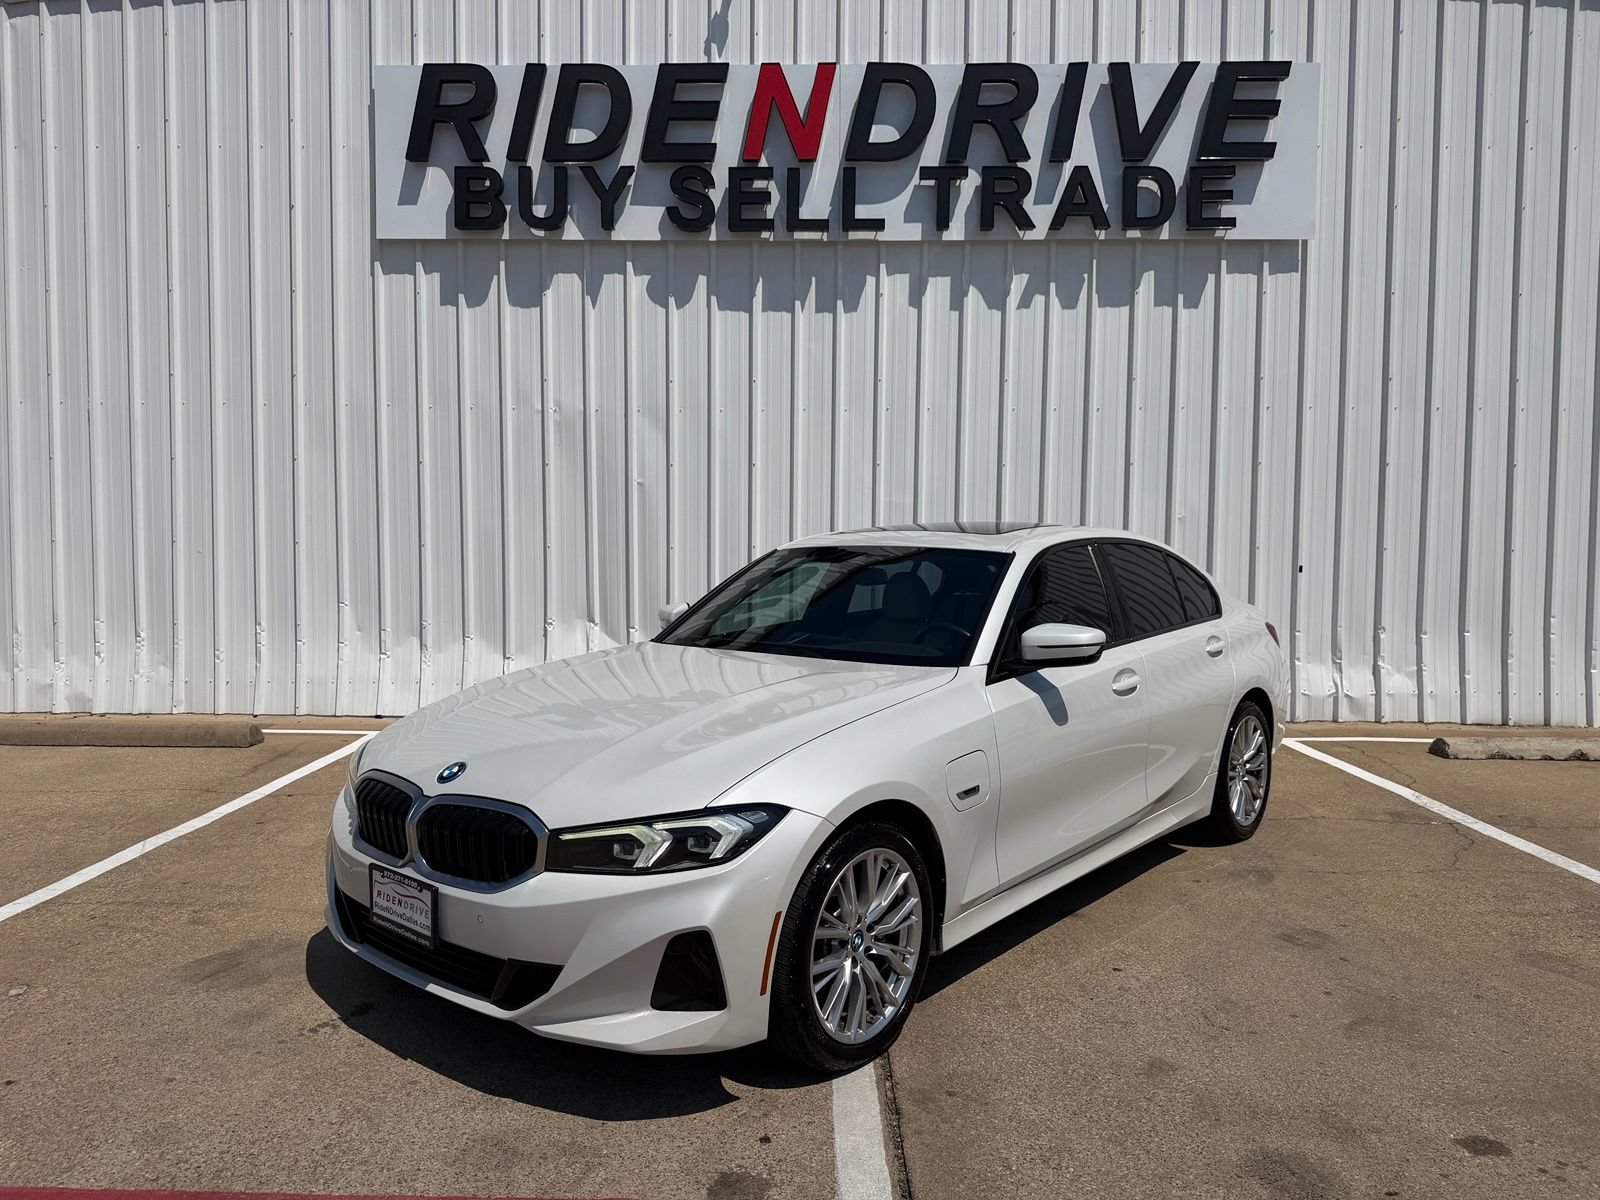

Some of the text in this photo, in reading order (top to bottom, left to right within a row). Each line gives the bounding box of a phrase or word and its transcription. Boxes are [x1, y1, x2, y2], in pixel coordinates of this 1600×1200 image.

[405, 61, 1292, 163] RIDENDRIVE
[453, 165, 1237, 232] BUY SELL TRADE
[374, 901, 431, 932] RideNDriveDallas.com
[376, 889, 430, 919] RIDENDRIVE
